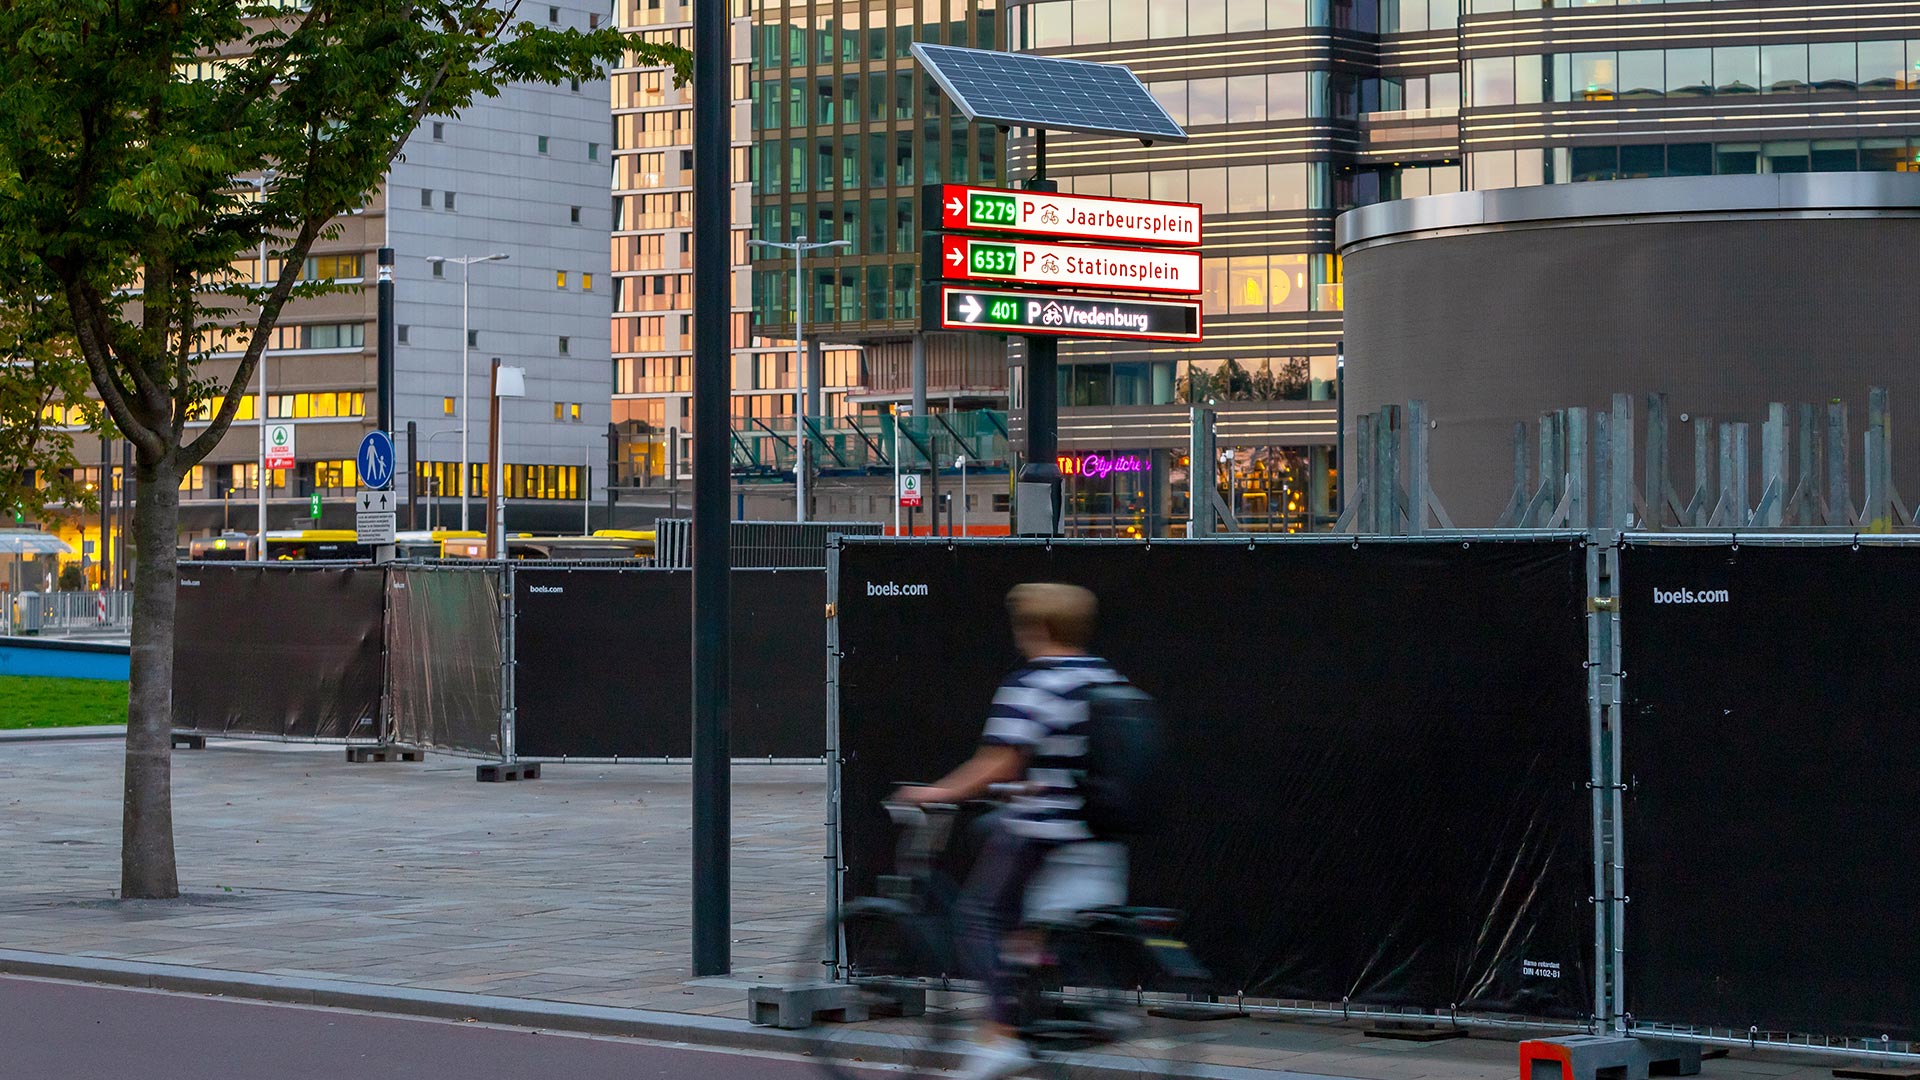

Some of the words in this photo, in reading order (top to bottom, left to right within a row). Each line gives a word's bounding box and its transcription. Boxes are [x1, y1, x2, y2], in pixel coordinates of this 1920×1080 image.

[975, 200, 1016, 222] 2279
[1023, 201, 1036, 223] P
[1066, 207, 1193, 234] Jaarbeursplein
[974, 250, 1016, 273] 6537
[1023, 251, 1036, 272] P
[1066, 256, 1180, 282] Stationsplein
[991, 301, 1018, 321] 401
[1028, 303, 1042, 323] P
[1062, 304, 1149, 333] Vredenburg
[312, 495, 319, 505] H
[313, 505, 319, 514] 2
[529, 585, 564, 593] boels.com
[866, 581, 929, 597] boels.com
[1653, 587, 1729, 605] boels.com
[1523, 967, 1535, 976] DIN
